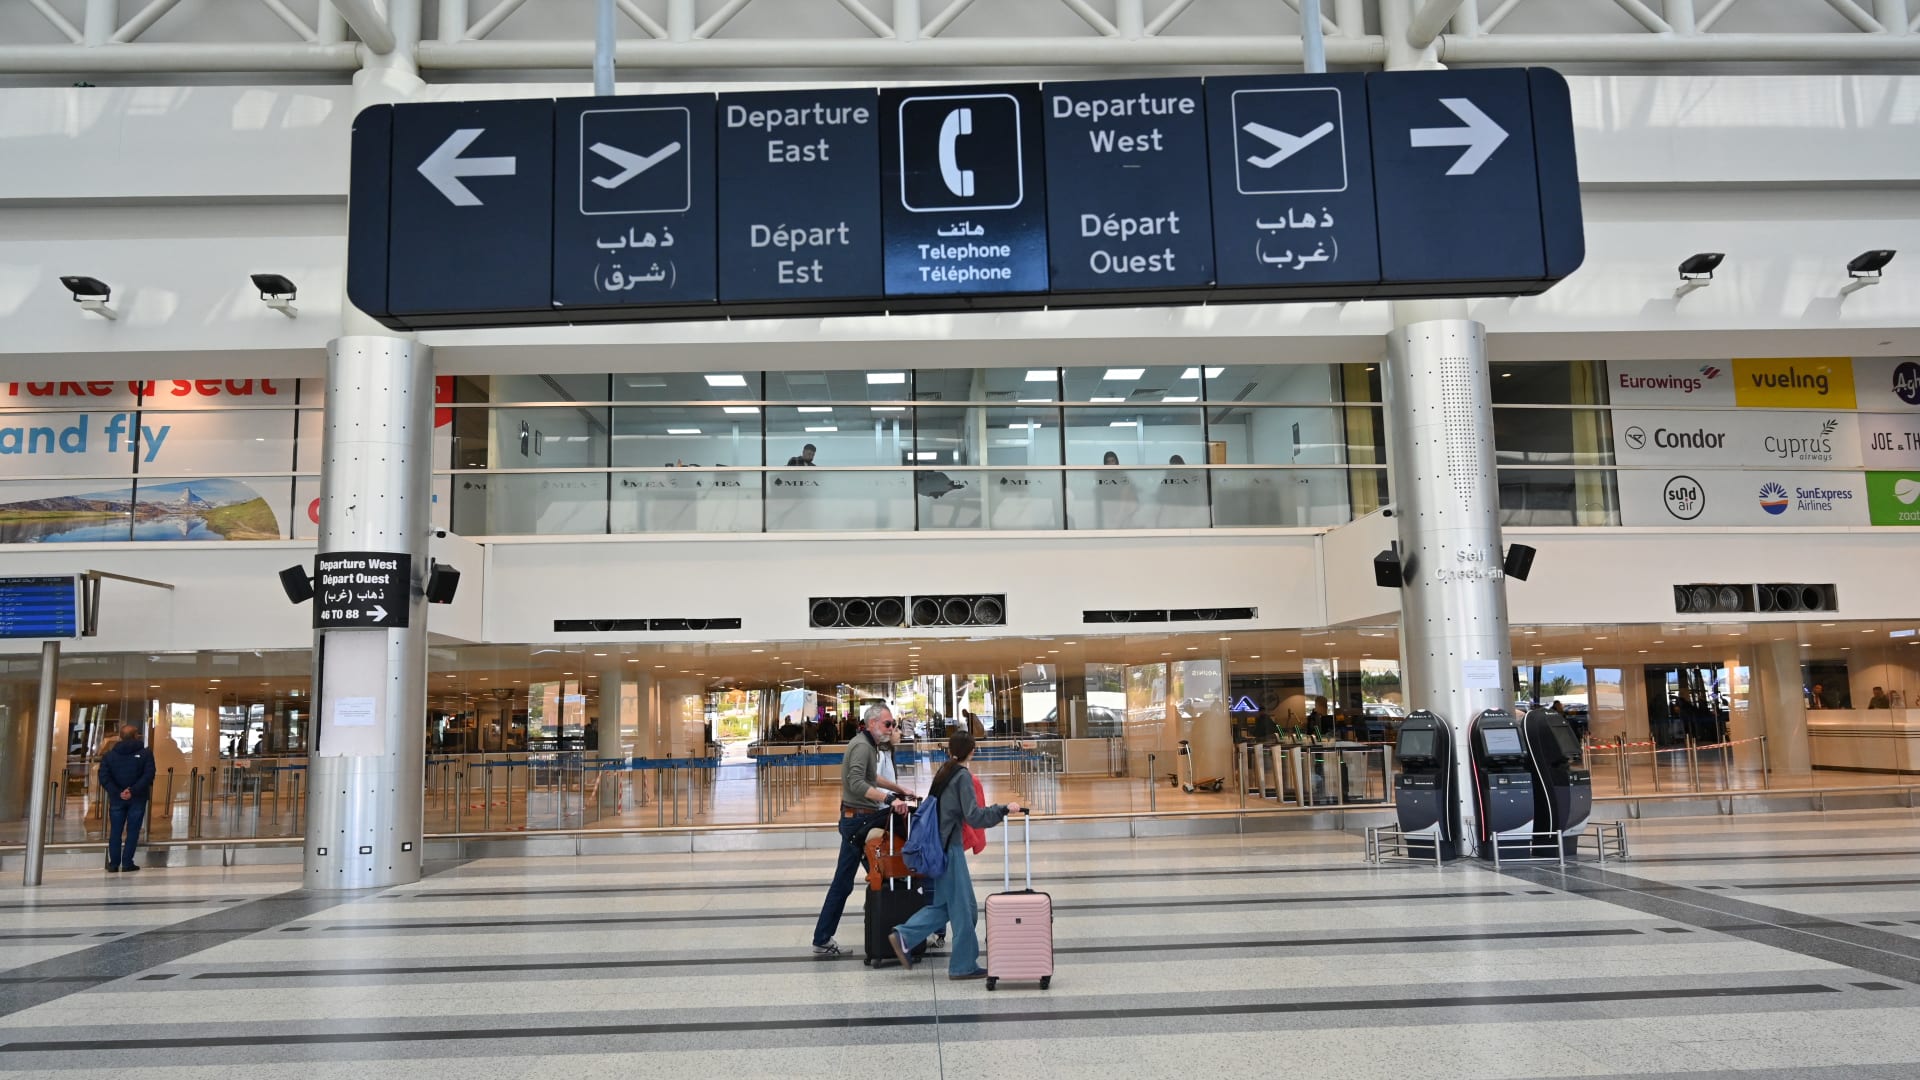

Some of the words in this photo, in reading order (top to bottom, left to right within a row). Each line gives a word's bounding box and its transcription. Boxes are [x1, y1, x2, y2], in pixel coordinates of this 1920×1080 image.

[727, 102, 869, 131] Departure
[1053, 91, 1195, 121] Departure
[768, 139, 829, 163] East
[1090, 128, 1163, 153] West
[937, 220, 985, 236] هاتف
[1081, 211, 1180, 241] Départ
[1256, 206, 1334, 235] ذهاب
[596, 226, 674, 254] ذهاب
[750, 222, 850, 251] Départ
[918, 242, 1011, 261] Telephone
[1090, 248, 1175, 274] Ouest
[1256, 235, 1338, 270] (غرب)
[594, 260, 677, 292] (شرق)
[778, 260, 823, 284] Est
[918, 265, 1012, 283] Téléphone
[1619, 373, 1702, 393] Eurowings
[1752, 366, 1828, 395] vueling
[0, 413, 88, 454] and
[104, 413, 171, 463] fly
[1654, 428, 1725, 449] Condor
[1871, 432, 1894, 450] JOE
[1799, 453, 1833, 463] airways
[1795, 487, 1853, 501] SunExpress
[1797, 499, 1833, 511] Airlines
[320, 558, 366, 572] Departure
[368, 558, 398, 571] West
[1457, 547, 1487, 562] Self
[322, 573, 354, 586] Départ
[355, 572, 390, 585] Ouest
[356, 588, 385, 602] ذهاب
[320, 610, 331, 620] 46
[331, 609, 344, 619] TO
[345, 609, 360, 619] 88
